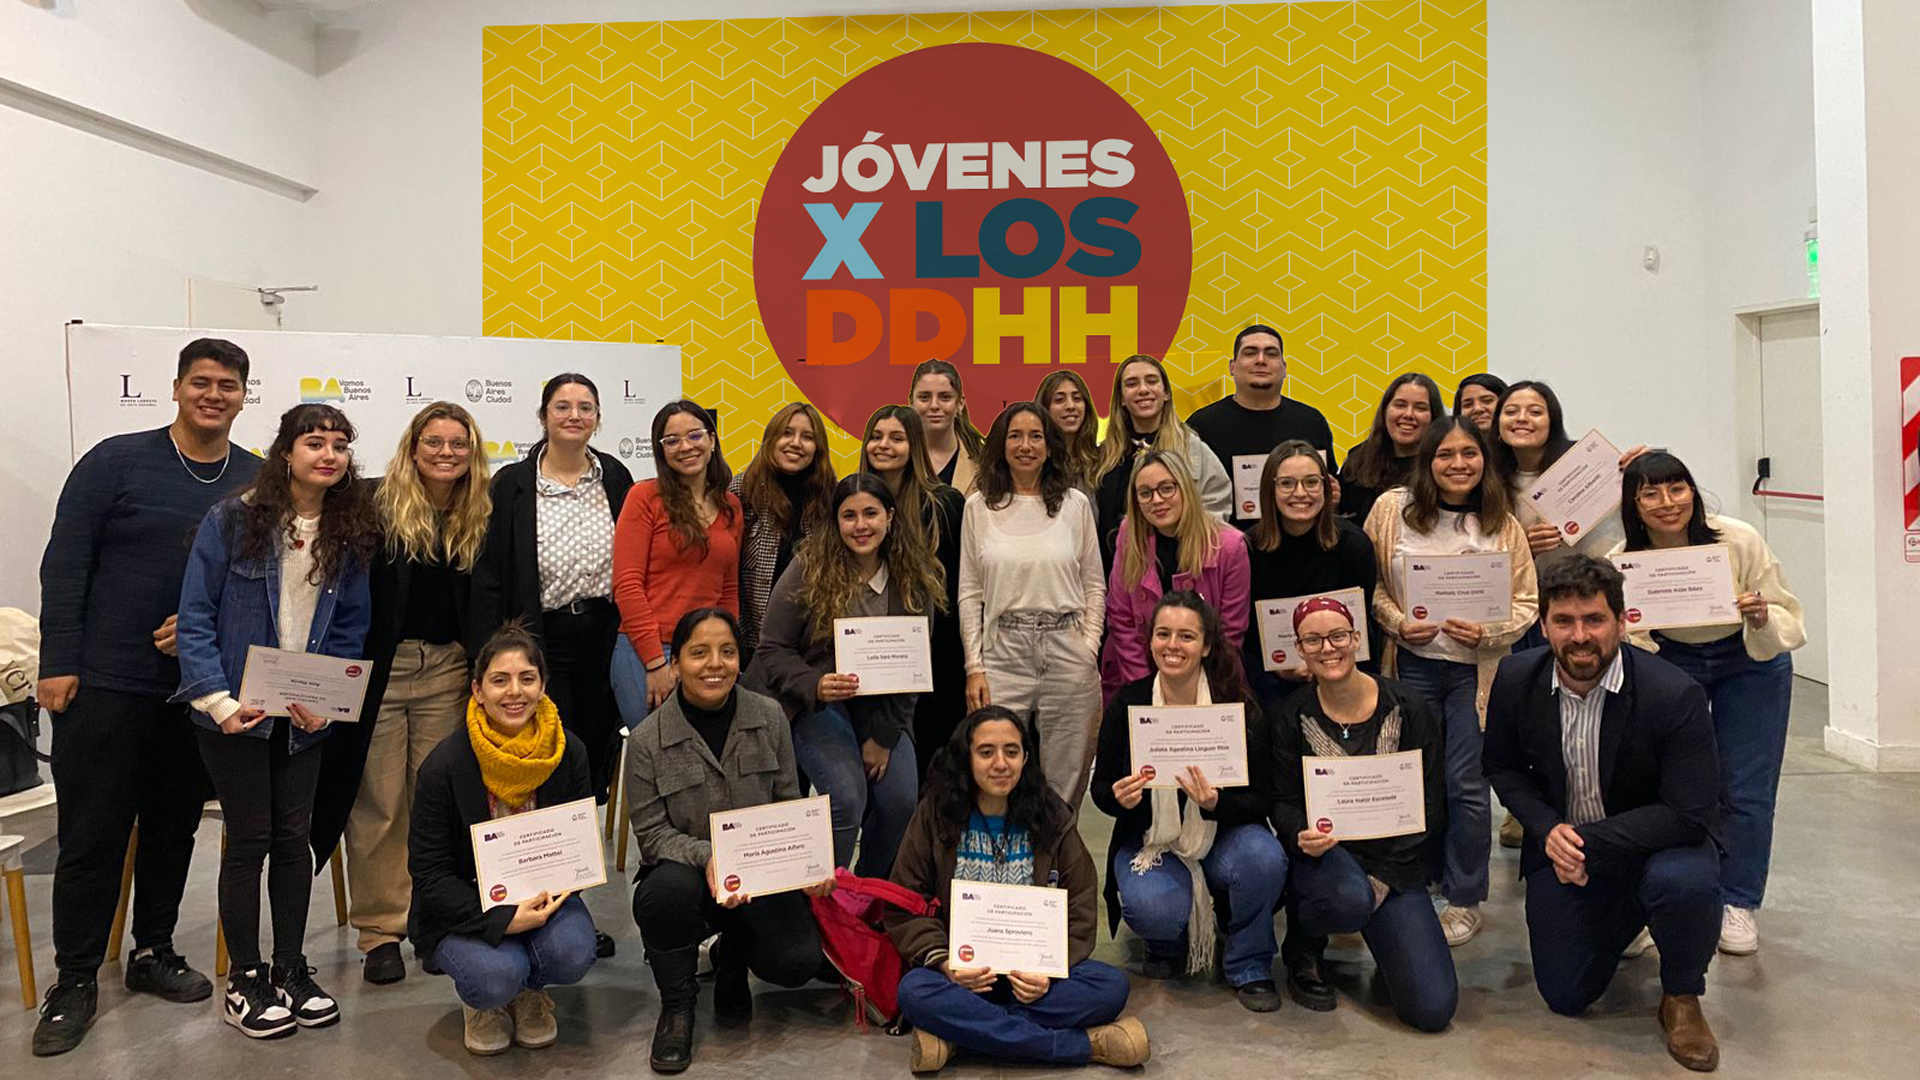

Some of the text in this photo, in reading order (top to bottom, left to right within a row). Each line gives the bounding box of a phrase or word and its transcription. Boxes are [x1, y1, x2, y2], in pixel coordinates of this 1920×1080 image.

[802, 131, 1136, 193] JÓVENES
[801, 197, 1142, 280] X LOS
[806, 285, 1138, 366] DDHH
[120, 374, 141, 398] L
[406, 376, 421, 397] L
[486, 379, 512, 387] Buenos
[624, 380, 636, 398] L
